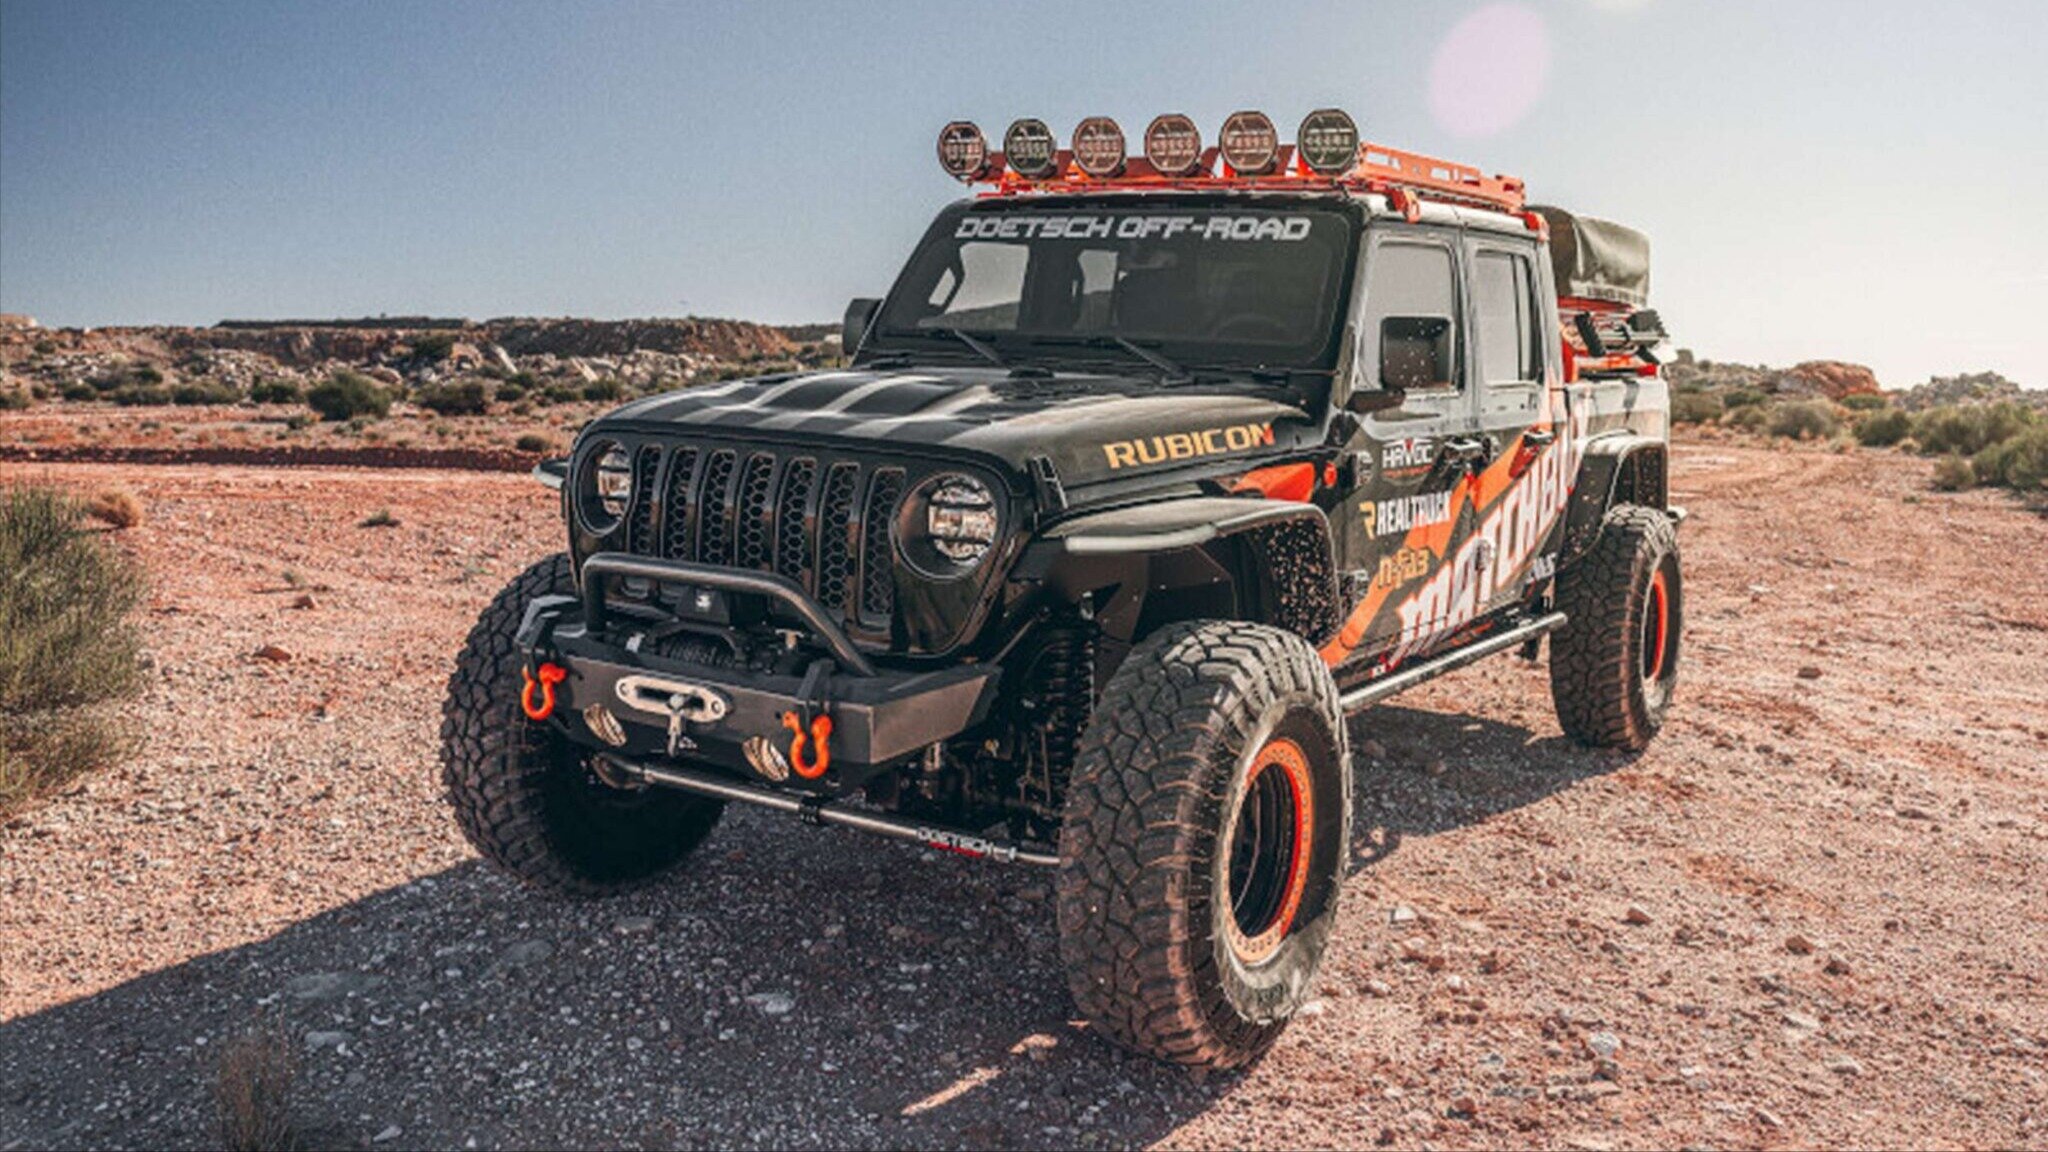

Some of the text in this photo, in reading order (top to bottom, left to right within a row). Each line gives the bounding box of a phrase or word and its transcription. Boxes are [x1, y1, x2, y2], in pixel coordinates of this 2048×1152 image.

[955, 216, 1312, 241] DOETSCH OFF-ROAD
[1102, 422, 1275, 469] RUBICON
[1377, 490, 1452, 536] REALTRUCK
